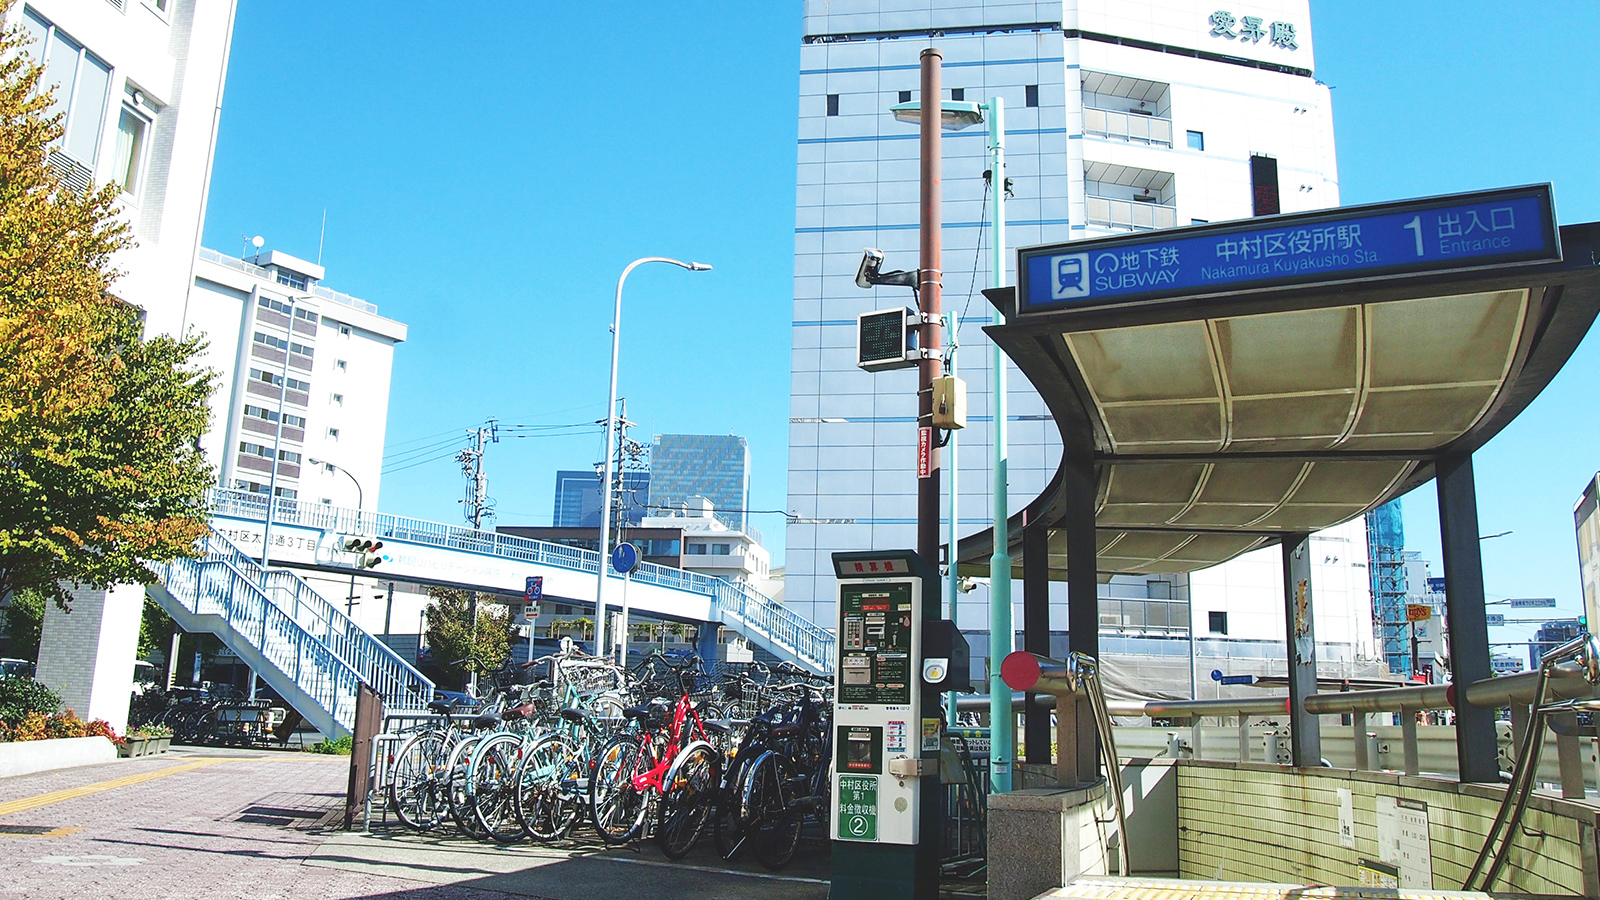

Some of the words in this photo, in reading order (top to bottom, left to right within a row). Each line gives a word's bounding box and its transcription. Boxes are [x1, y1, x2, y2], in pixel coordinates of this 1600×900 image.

[1208, 10, 1299, 51] 愛昇殿
[1121, 246, 1180, 270] 地下鉄
[1216, 224, 1362, 262] 中村区役所駅
[1403, 215, 1424, 256] 1
[1438, 207, 1515, 238] 出入口
[1095, 269, 1180, 291] SUBWAY
[1201, 262, 1270, 280] Nakamura
[1274, 252, 1350, 274] Kuyakusho
[1440, 236, 1511, 254] Entrance
[840, 780, 877, 791] 中村区役所
